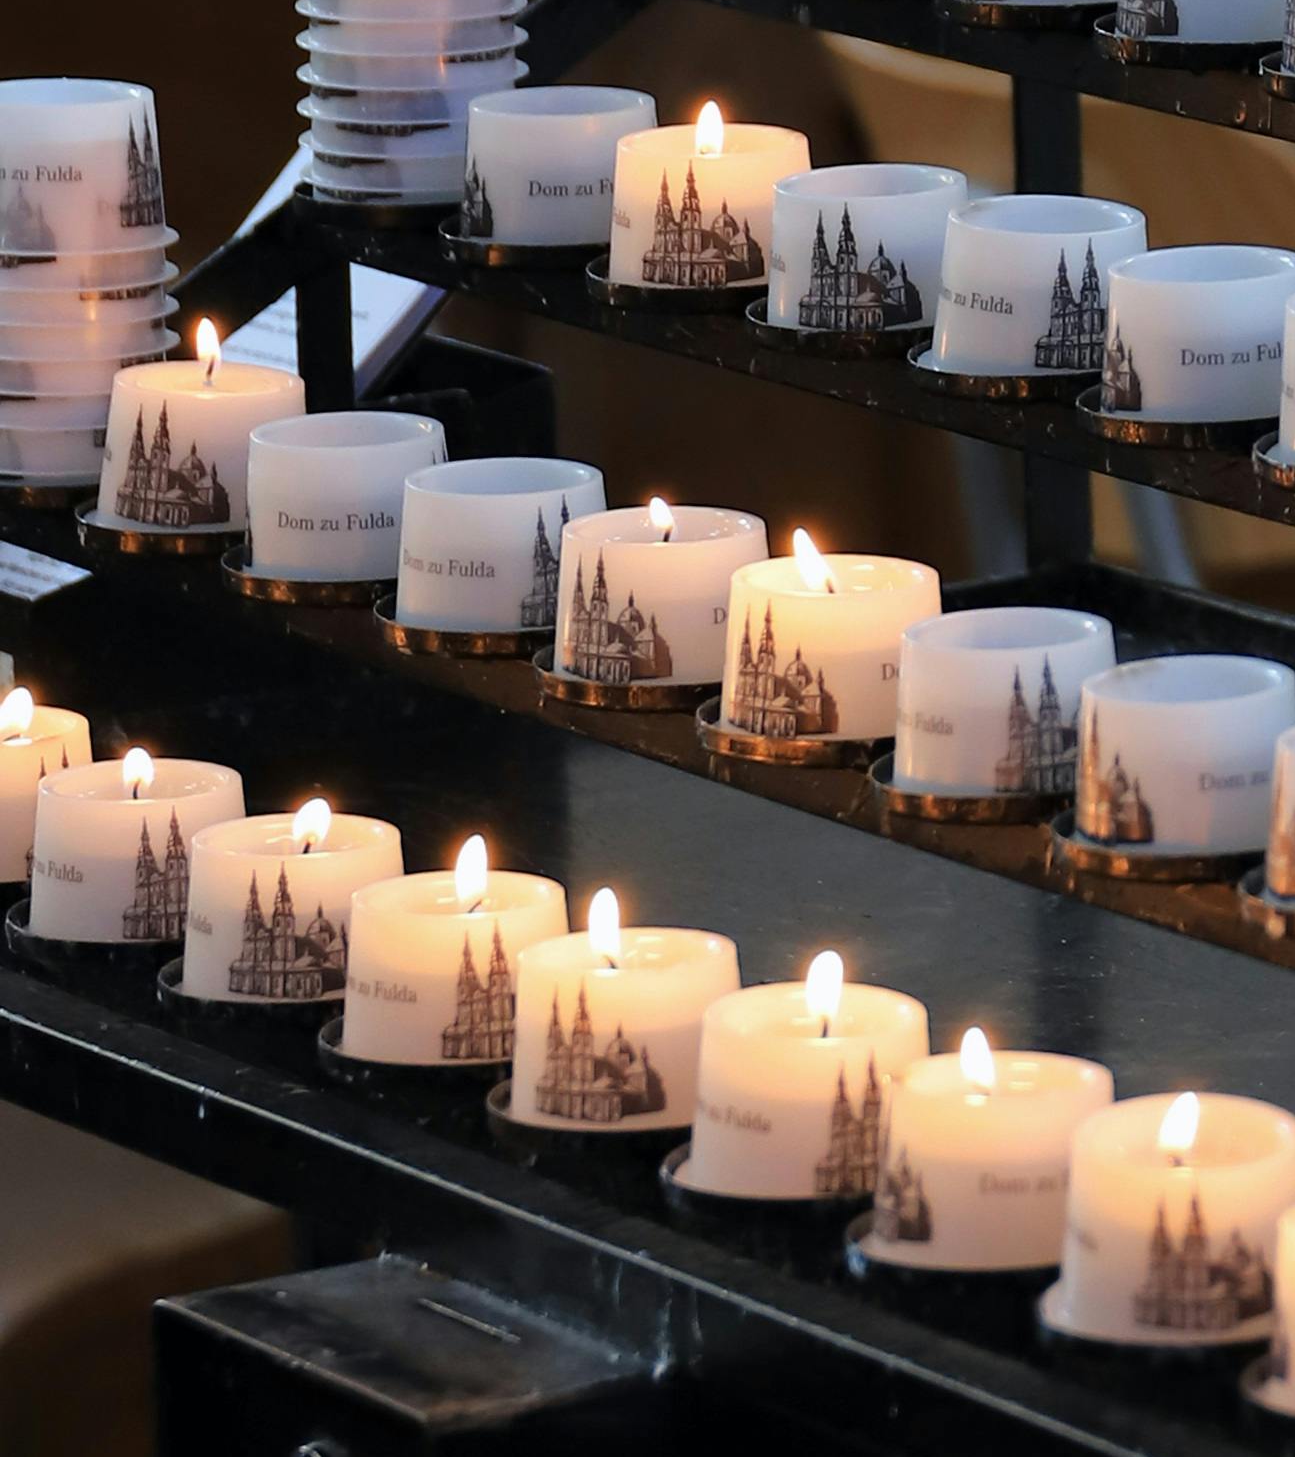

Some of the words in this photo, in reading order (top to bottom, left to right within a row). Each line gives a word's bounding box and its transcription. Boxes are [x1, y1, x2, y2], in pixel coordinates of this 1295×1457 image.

[11, 167, 30, 181] zu
[36, 165, 83, 183] Fulda
[528, 180, 569, 197] Dom
[574, 183, 594, 196] zu
[970, 292, 1013, 315] Fulda
[1180, 348, 1225, 366] Dom
[1231, 349, 1250, 364] zu
[277, 511, 315, 531] Dom
[320, 517, 340, 532] zu
[346, 512, 395, 530] Fulda
[426, 560, 443, 575] zu
[448, 559, 496, 579] Fulda
[47, 858, 84, 884] Fulda
[374, 979, 417, 1004] Fulda
